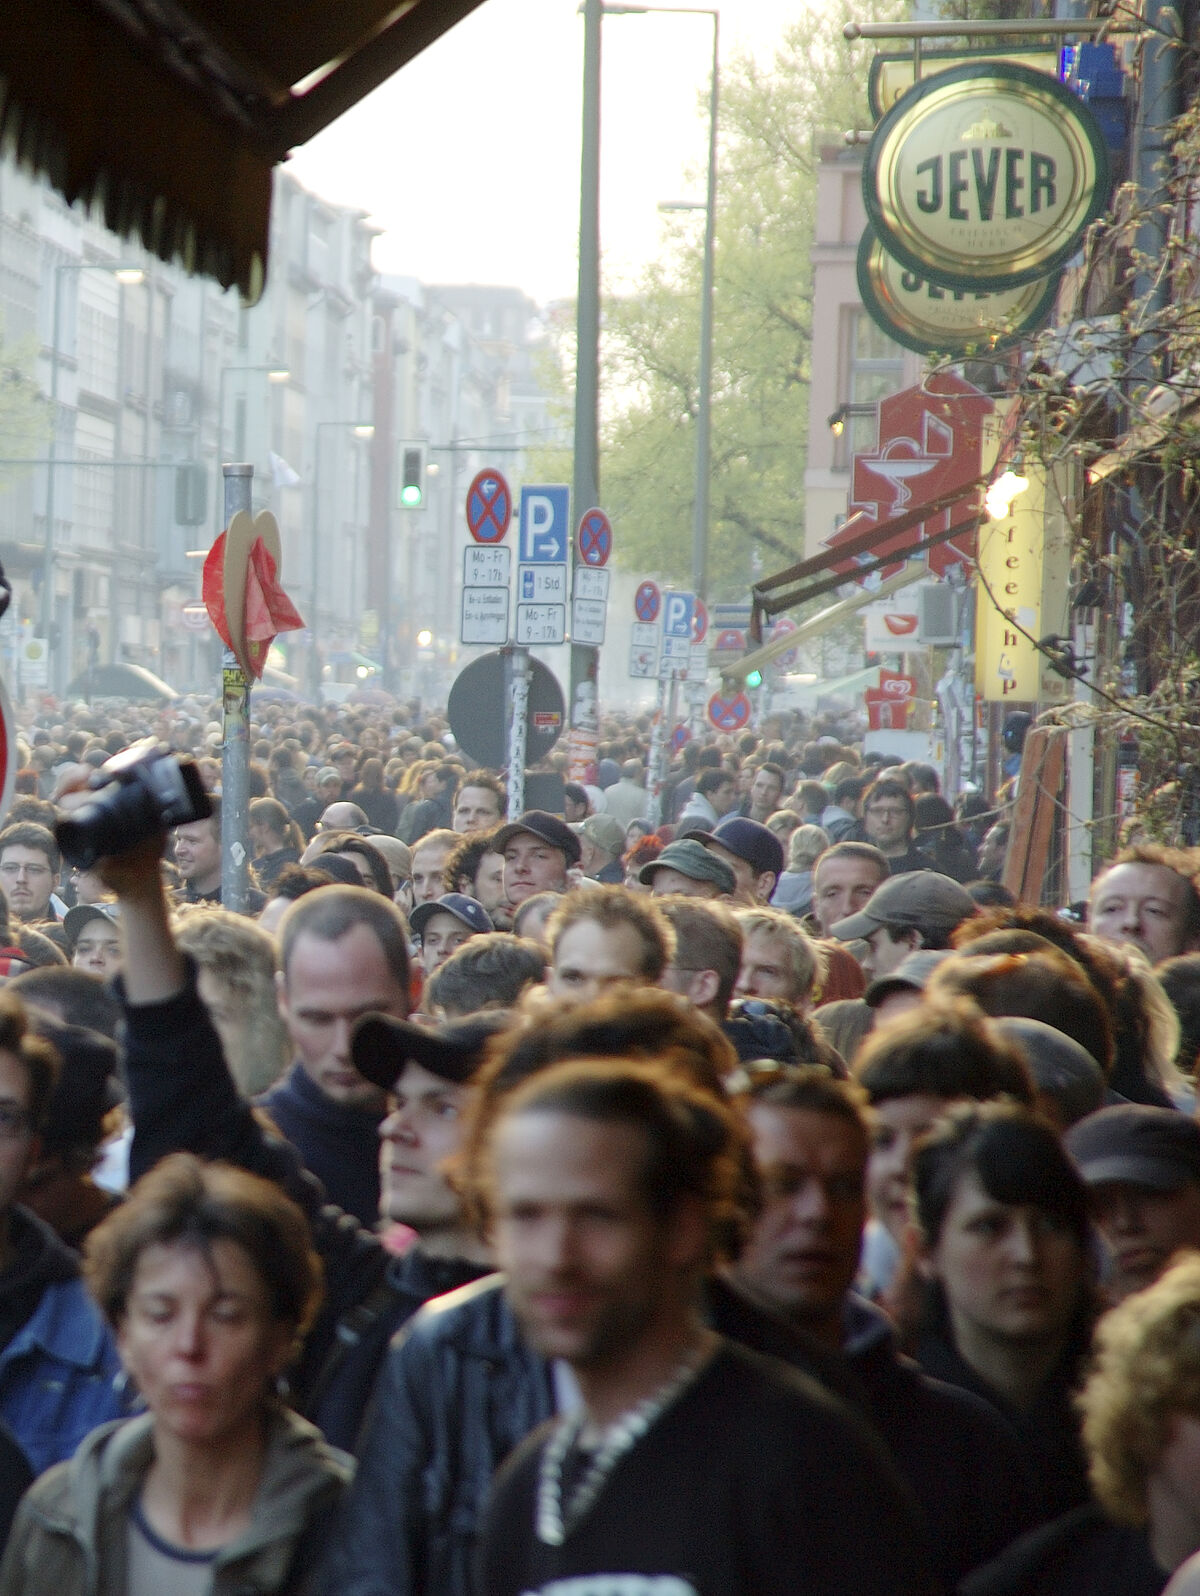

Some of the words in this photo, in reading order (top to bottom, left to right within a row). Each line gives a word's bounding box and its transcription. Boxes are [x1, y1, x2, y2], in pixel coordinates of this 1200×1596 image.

[915, 147, 1057, 222] JEVER
[526, 495, 555, 558] P
[666, 597, 686, 633] P
